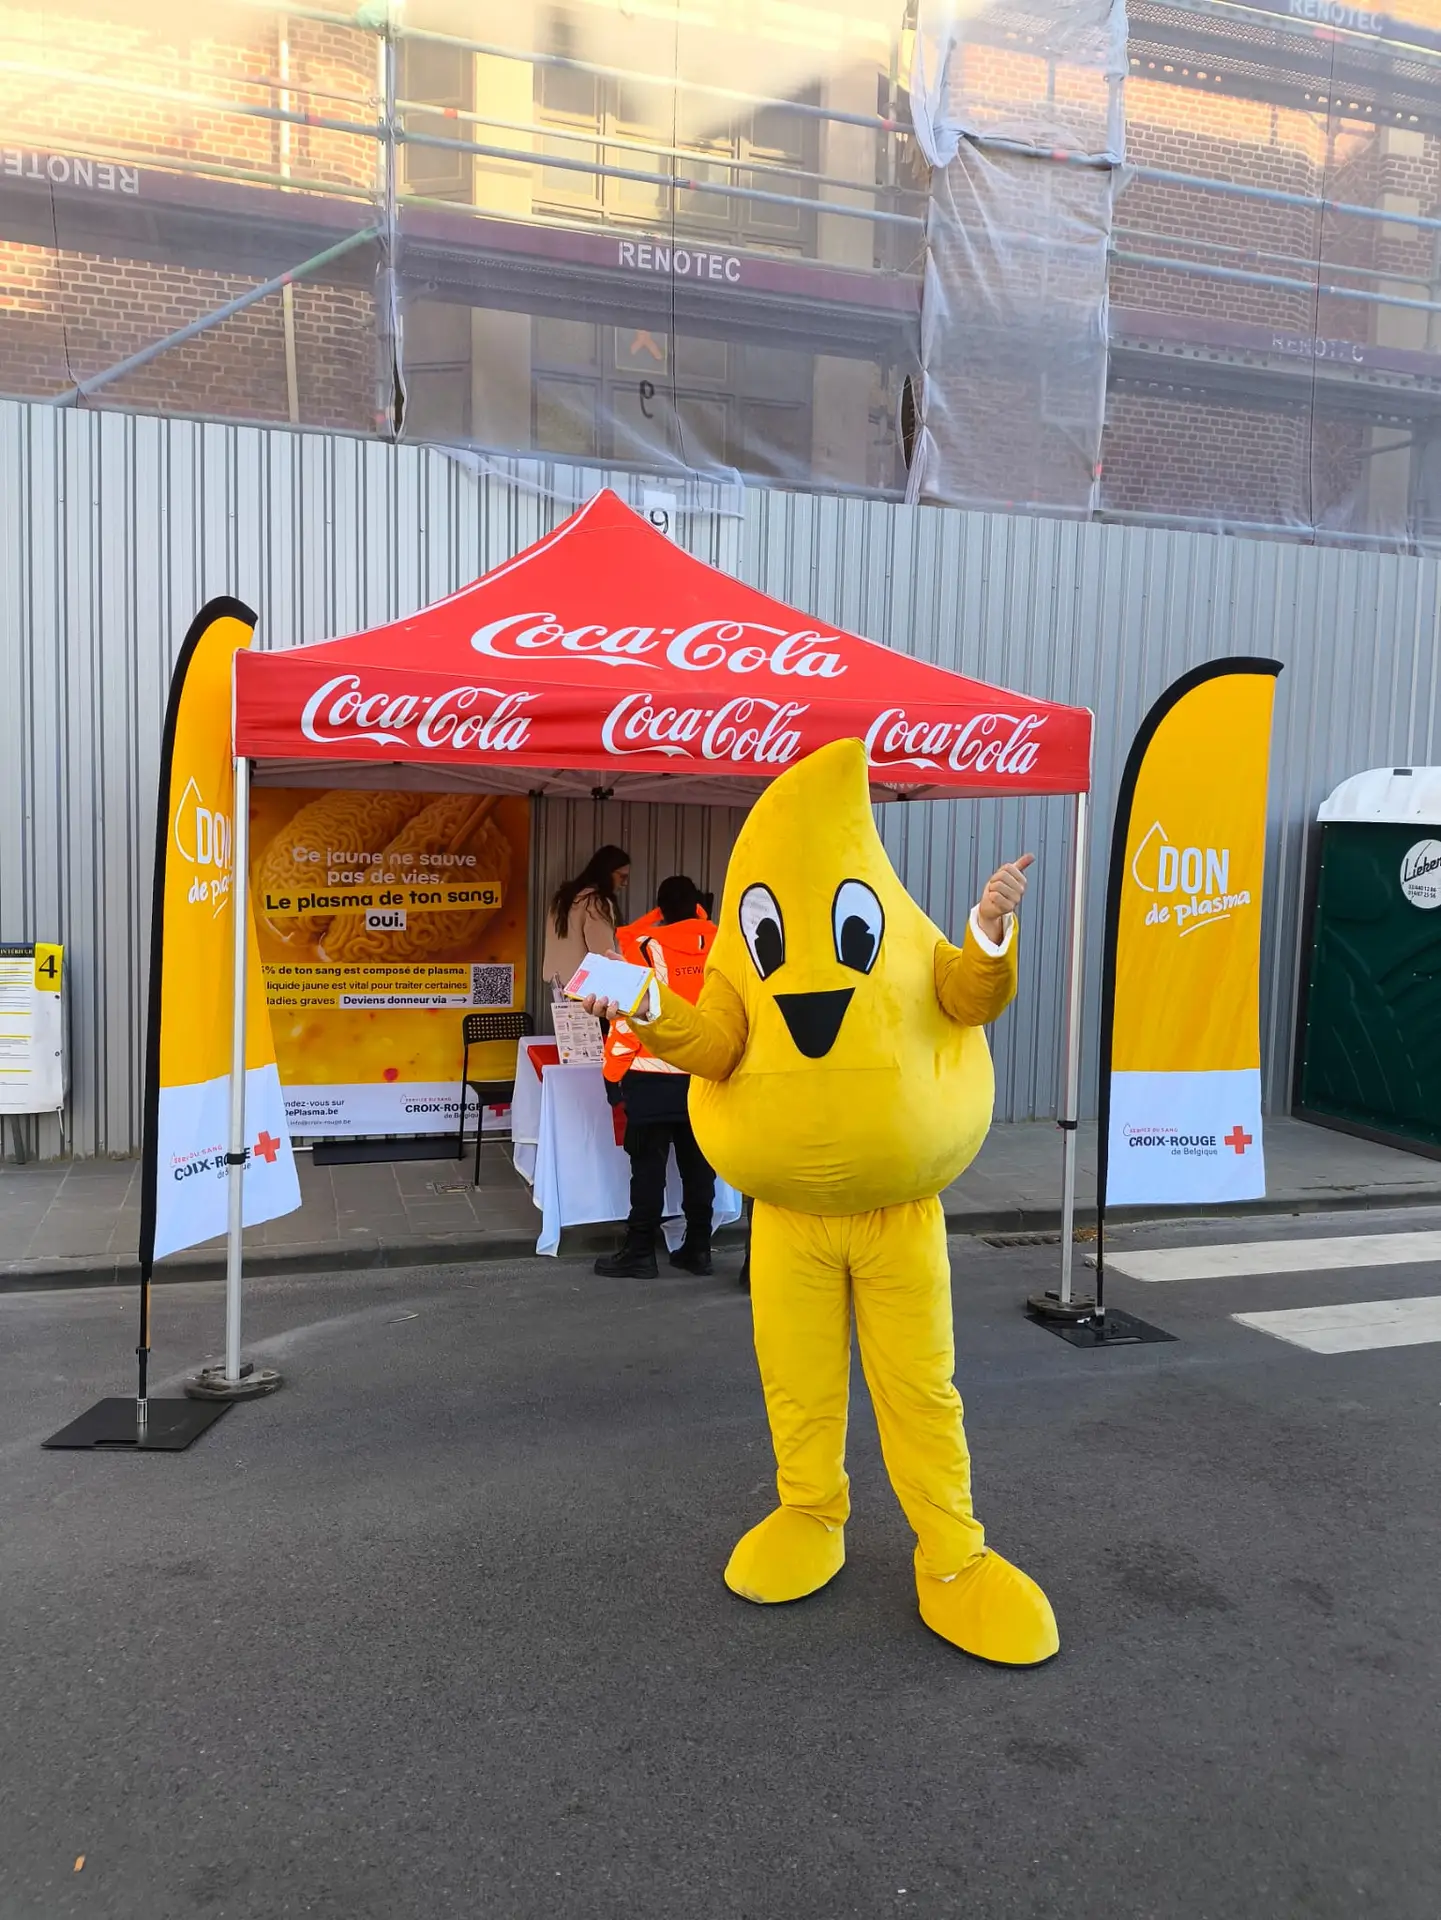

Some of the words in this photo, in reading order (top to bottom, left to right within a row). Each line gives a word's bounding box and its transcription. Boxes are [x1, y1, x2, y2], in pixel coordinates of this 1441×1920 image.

[0, 148, 139, 194] RENOTE
[618, 241, 741, 282] RENOTEC
[650, 507, 669, 535] 9
[471, 612, 848, 679] Coca-Cola
[301, 674, 545, 751] Coca-Cola
[601, 693, 811, 763] Coca-Cola
[864, 708, 1049, 774] Coca-Cola
[292, 846, 321, 864] Ce
[326, 847, 383, 866] jaune
[389, 853, 414, 866] ne
[419, 853, 477, 867] sauve
[327, 870, 365, 886] pas
[370, 869, 397, 885] de
[1158, 845, 1230, 895] DON
[188, 876, 209, 904] de
[266, 894, 292, 910] Le
[297, 892, 373, 913] plasma
[379, 891, 404, 906] de
[409, 889, 443, 904] ton
[368, 912, 404, 928] oui.
[1145, 902, 1170, 926] de
[1174, 890, 1251, 926] plasma
[38, 955, 58, 979] 4
[278, 966, 292, 975] de
[295, 967, 313, 975] ton
[315, 968, 342, 977] sang
[344, 967, 361, 975] est
[363, 966, 410, 976] composé
[413, 966, 426, 975] de
[428, 966, 468, 976] plasma.
[266, 981, 300, 992] liquide
[301, 981, 330, 992] jaune
[331, 981, 347, 990] est
[349, 981, 369, 990] vital
[371, 982, 393, 991] pour
[395, 981, 423, 990] traiter
[425, 981, 468, 990] certaines
[266, 996, 298, 1005] ladies
[343, 995, 386, 1005] Deviens
[388, 995, 430, 1004] donneur
[432, 995, 447, 1004] via
[454, 1112, 480, 1120] Bgiqu
[1129, 1135, 1217, 1147] CROIX-ROUGE
[1183, 1147, 1218, 1157] Belgique
